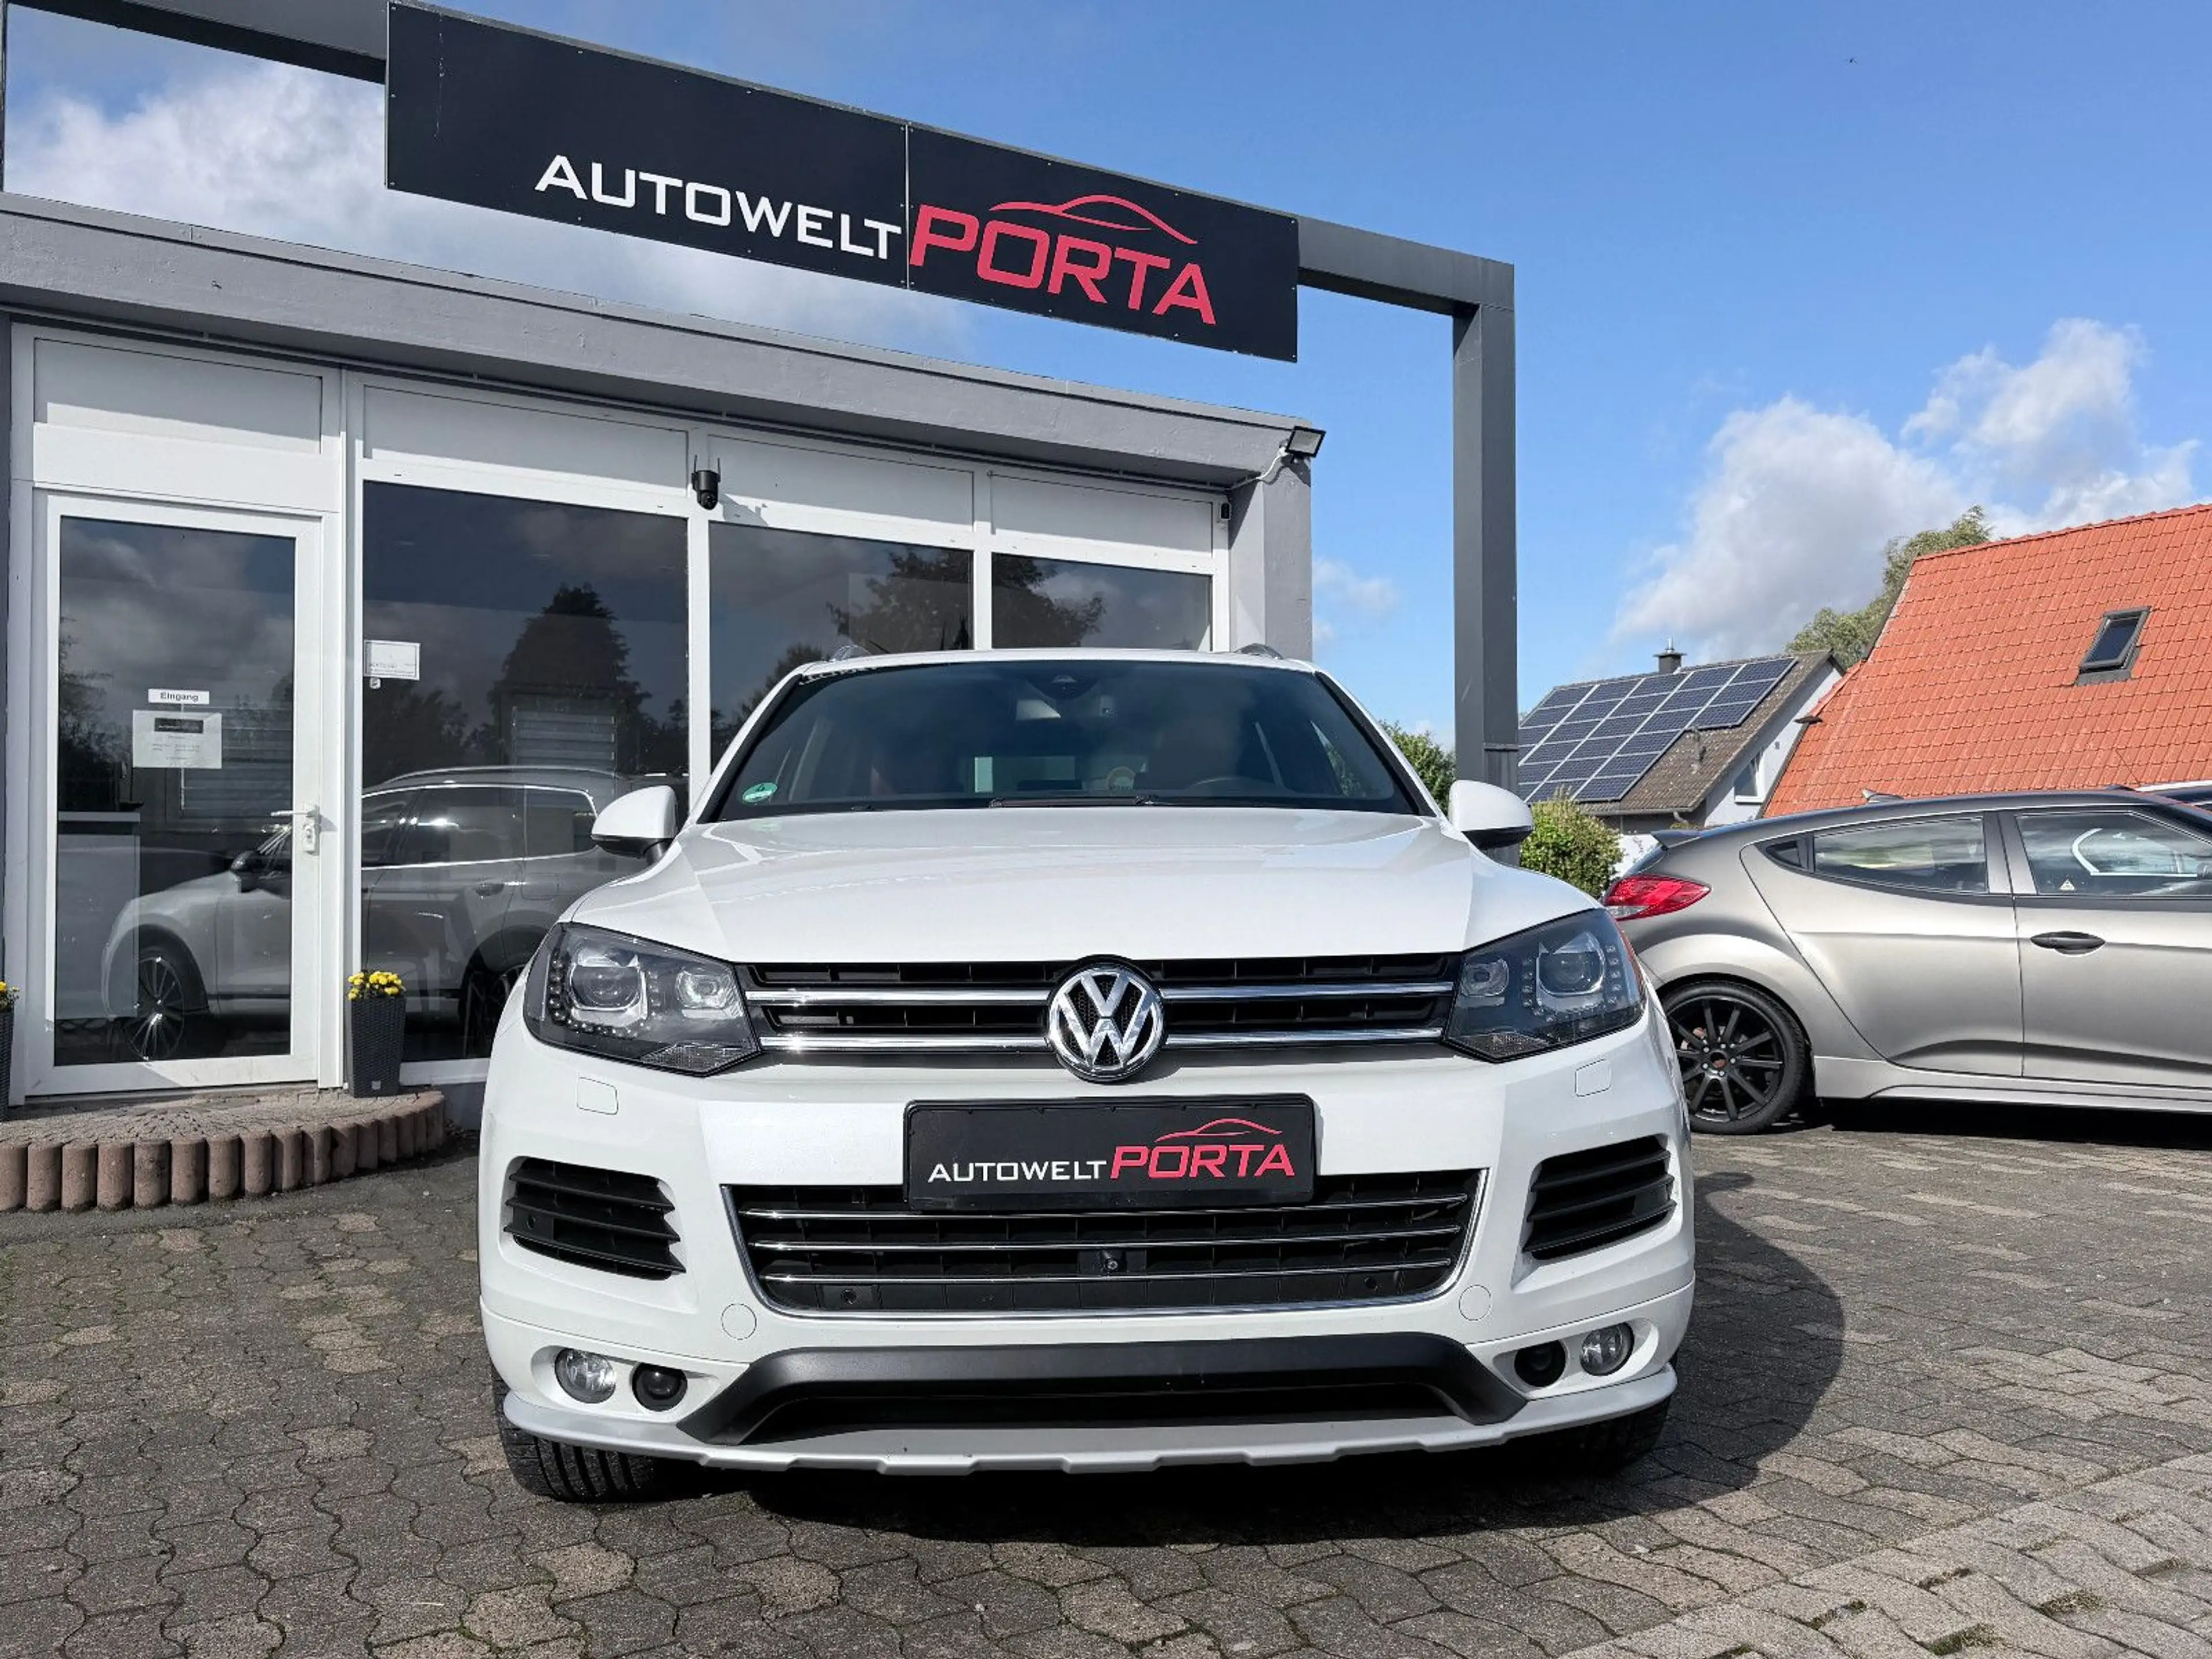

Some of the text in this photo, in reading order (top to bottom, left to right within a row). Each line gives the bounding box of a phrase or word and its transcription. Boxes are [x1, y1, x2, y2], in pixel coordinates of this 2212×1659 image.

[535, 155, 1215, 325] AUTOWELT PORTA
[160, 692, 199, 702] Eingang
[927, 1144, 1295, 1183] AUTOWELT PORTA
